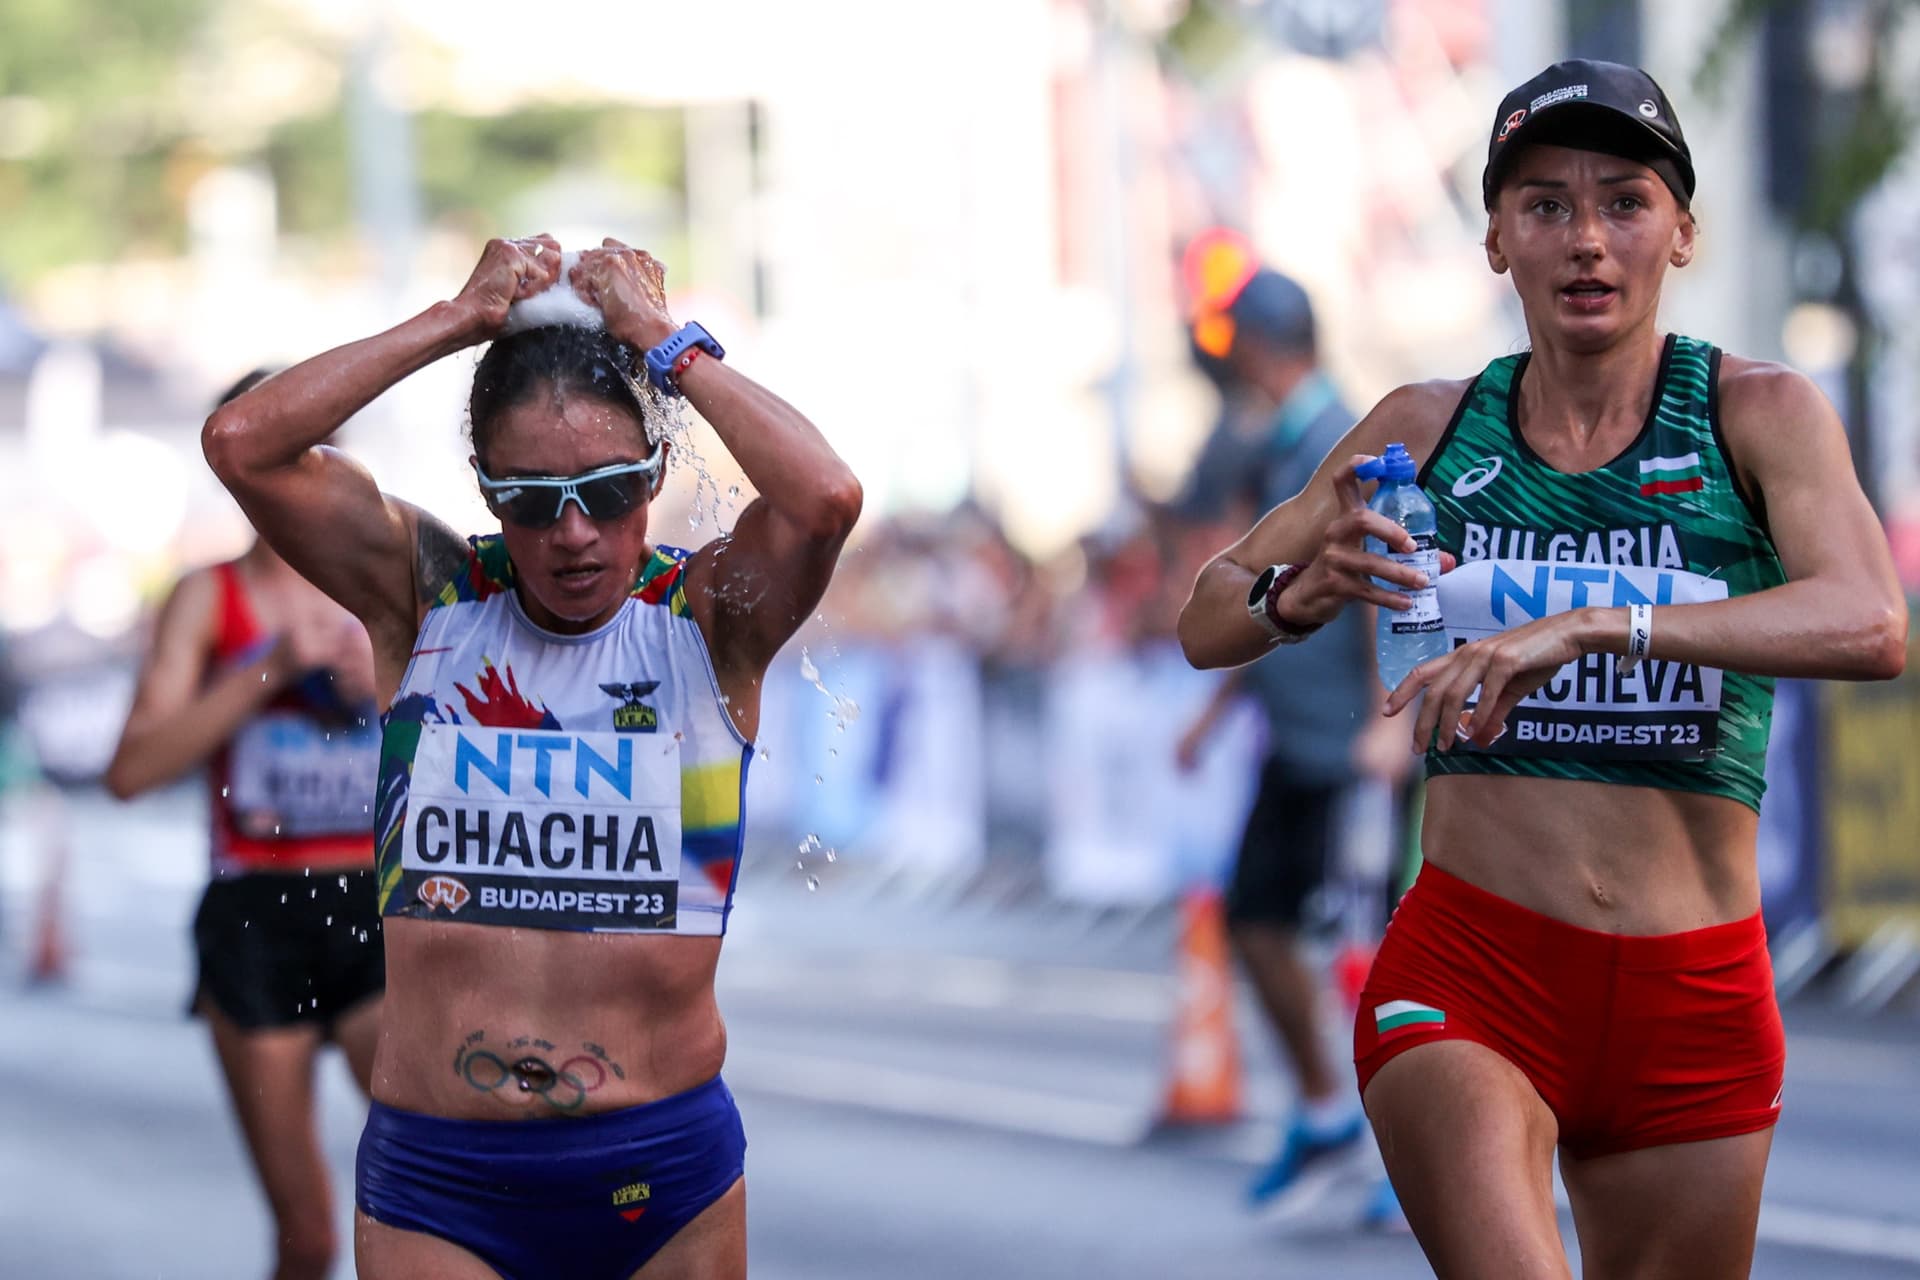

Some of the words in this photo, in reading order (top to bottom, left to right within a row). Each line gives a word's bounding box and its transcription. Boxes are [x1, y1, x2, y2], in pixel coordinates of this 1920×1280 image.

[1462, 522, 1684, 569] BULGARIA
[1490, 563, 1674, 626] NTN
[1516, 720, 1666, 745] BUDAPEST
[1669, 723, 1700, 744] 23
[454, 730, 633, 801] NTN
[415, 805, 662, 872] CHACHA
[480, 886, 630, 914] BUDAPEST
[634, 894, 665, 915] 23
